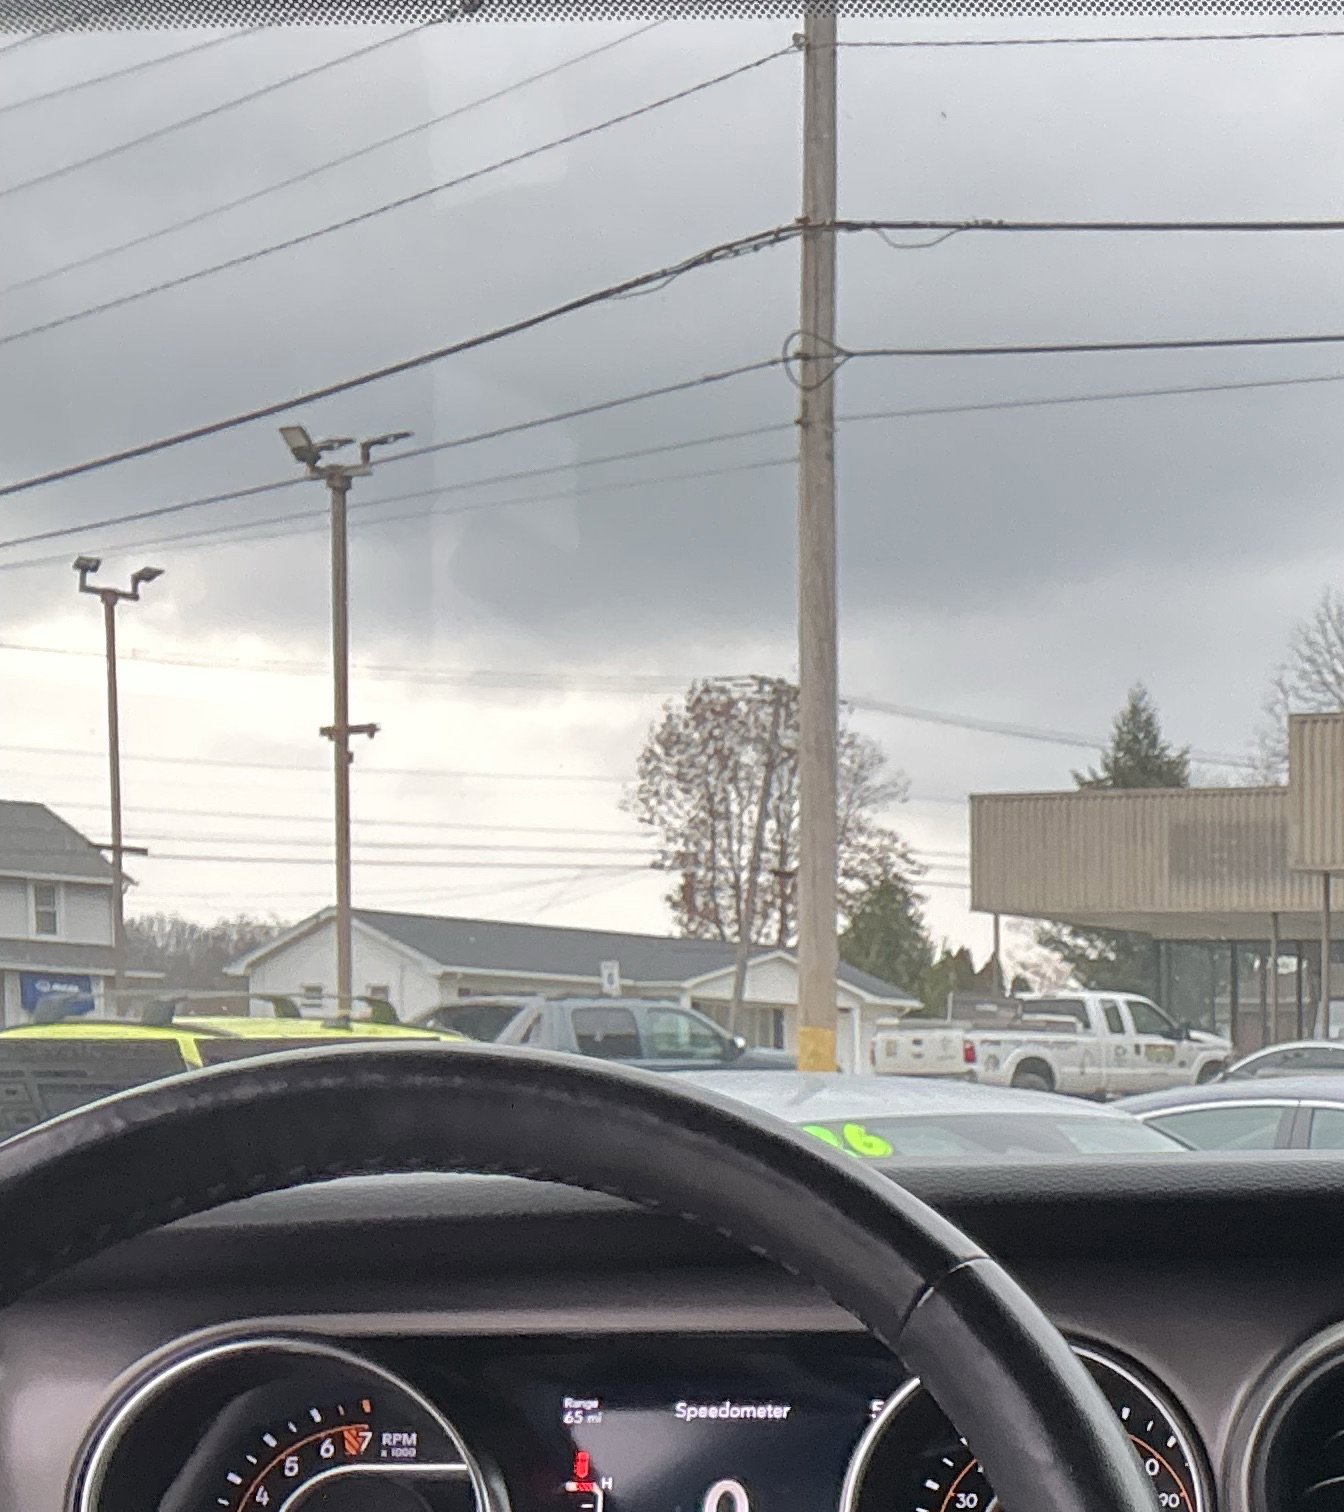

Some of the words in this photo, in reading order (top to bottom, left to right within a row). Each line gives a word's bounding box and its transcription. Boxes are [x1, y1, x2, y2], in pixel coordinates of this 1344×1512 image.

[563, 1410, 583, 1424] 65
[674, 1401, 791, 1421] Speedometer
[320, 1438, 335, 1459] 6
[359, 1431, 373, 1452] 7
[381, 1432, 417, 1446] RPM
[284, 1455, 299, 1477] 5
[601, 1478, 612, 1489] H
[255, 1485, 269, 1507] 4
[955, 1493, 978, 1509] 30
